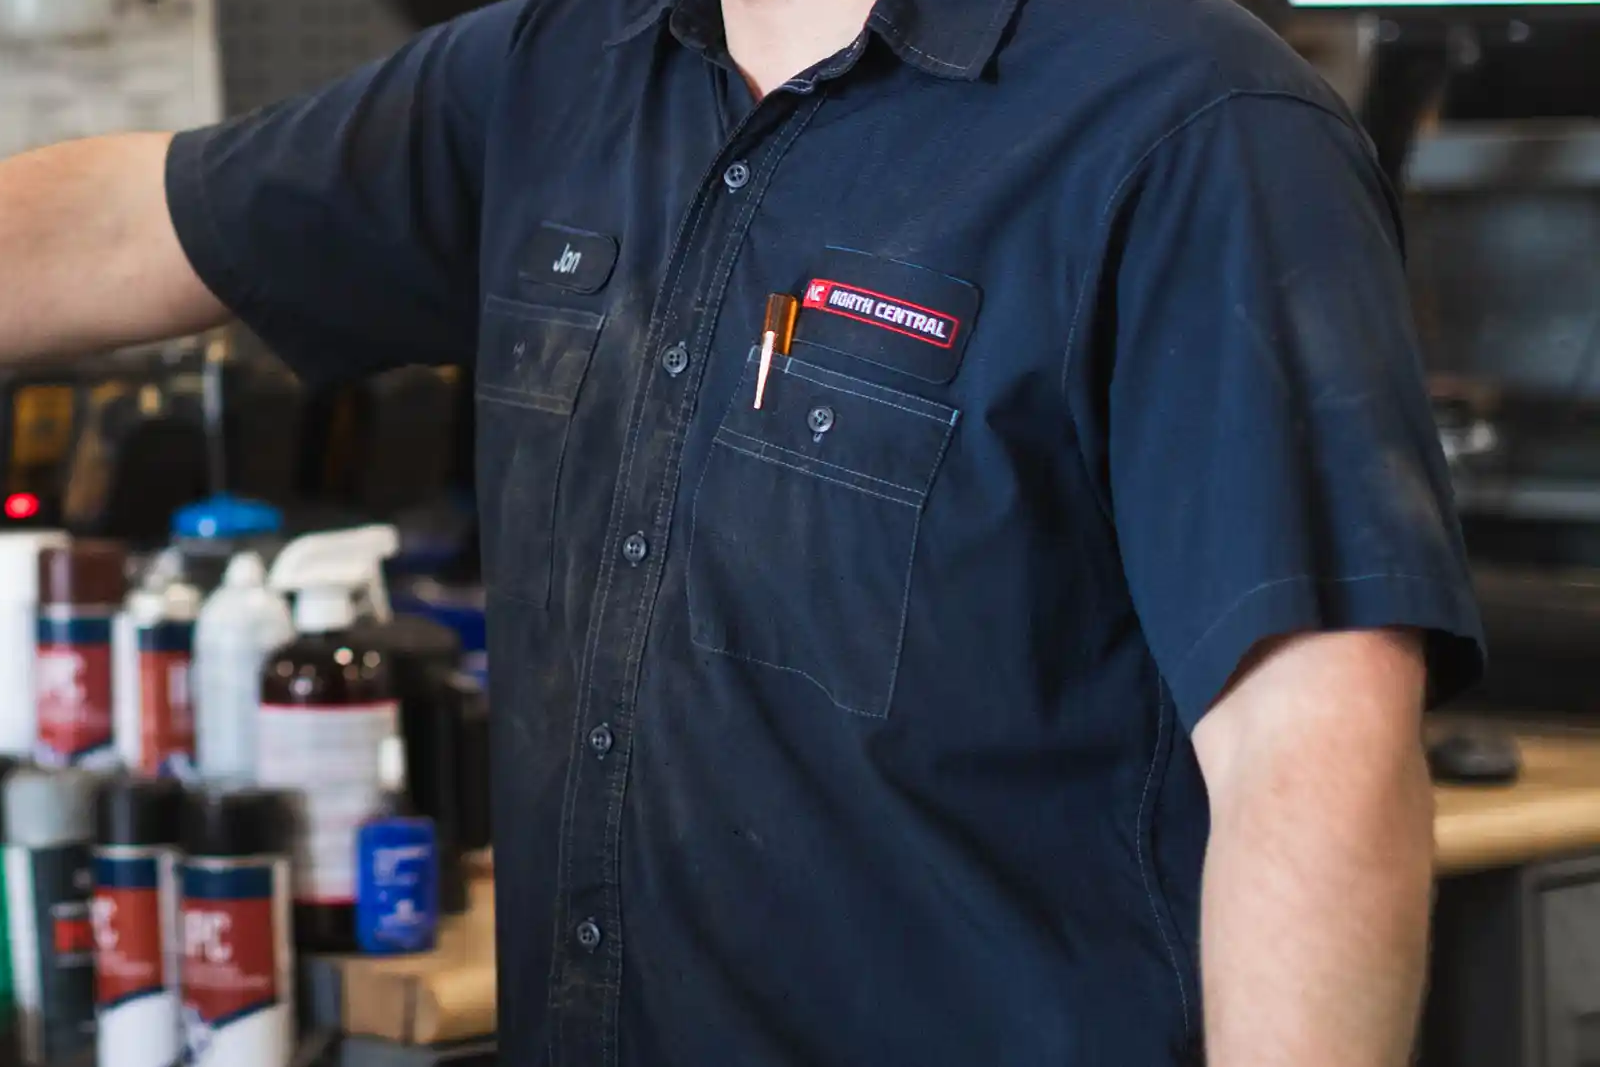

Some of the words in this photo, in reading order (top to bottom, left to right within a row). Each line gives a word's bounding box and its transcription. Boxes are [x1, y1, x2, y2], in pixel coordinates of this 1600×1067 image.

[552, 242, 582, 274] Jon
[829, 289, 875, 315] NORTH
[875, 302, 947, 339] CENTRAL
